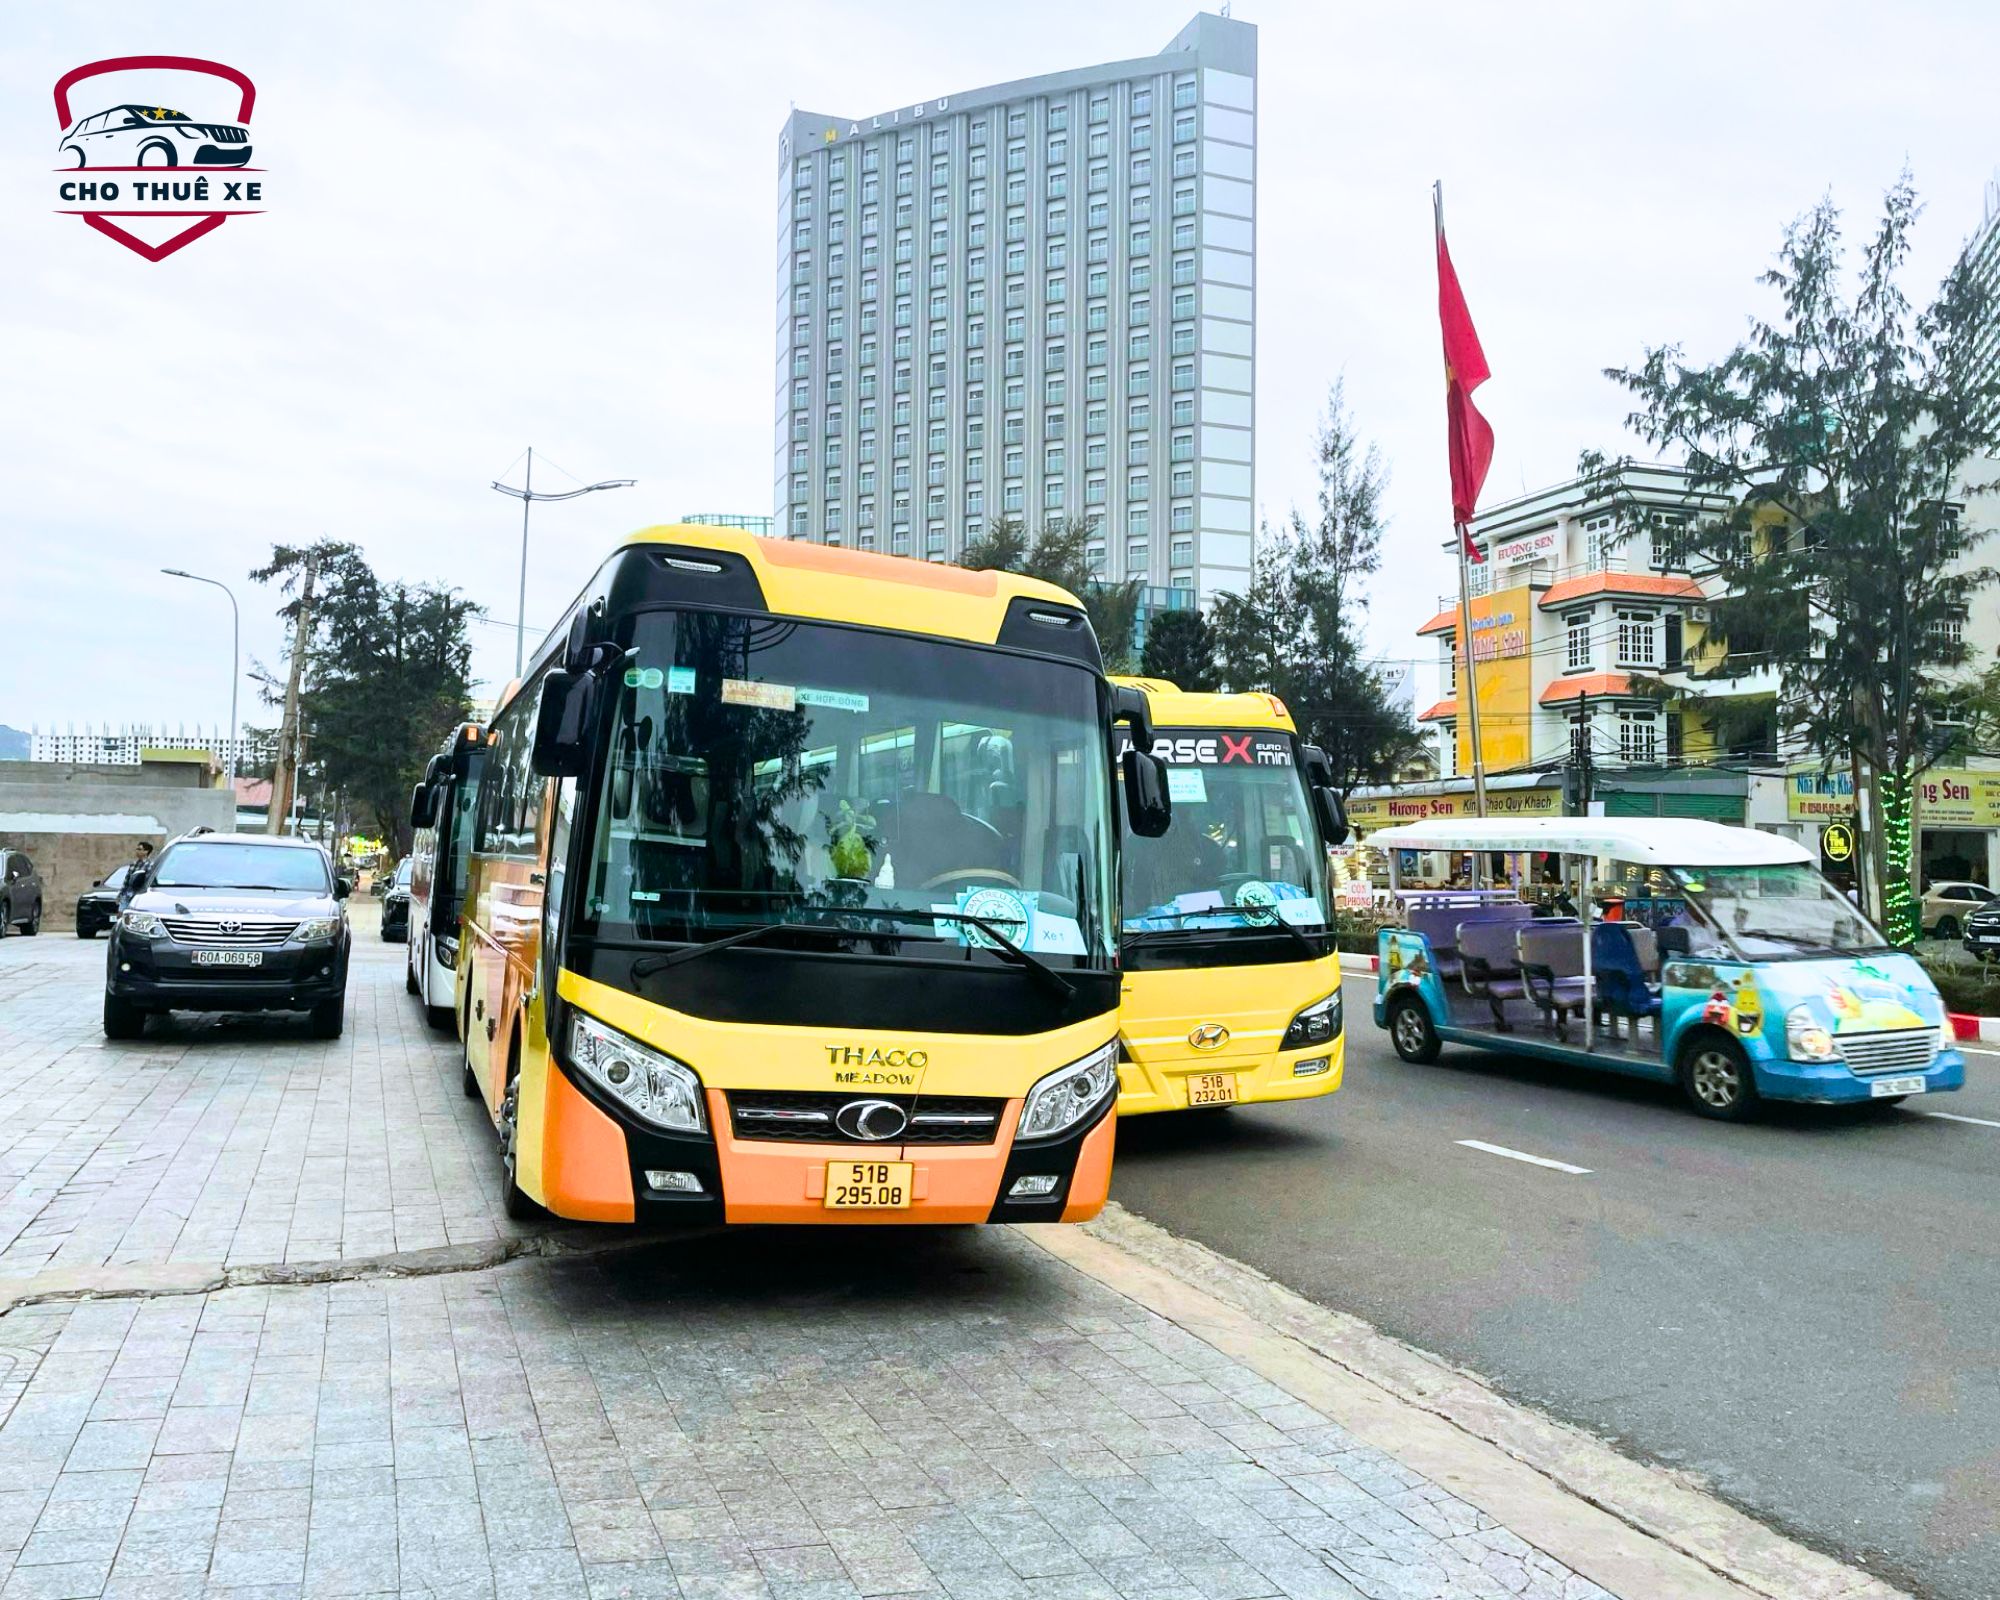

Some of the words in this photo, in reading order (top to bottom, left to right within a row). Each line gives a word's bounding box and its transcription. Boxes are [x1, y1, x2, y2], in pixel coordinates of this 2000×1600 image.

[825, 97, 949, 143] MALIBU
[1534, 534, 1554, 549] SEN
[1512, 551, 1539, 562] HOTEL
[1221, 735, 1254, 764] X
[1255, 743, 1281, 751] EURO
[1942, 778, 1969, 799] Sen
[1389, 801, 1427, 818] Hương
[1430, 799, 1453, 815] Sen
[1463, 799, 1476, 811] Kín
[825, 1044, 928, 1068] THACO
[835, 1071, 915, 1085] MEADOW
[1201, 1075, 1224, 1089] 51B
[1195, 1088, 1232, 1103] 232.01
[852, 1164, 889, 1184] 51B
[835, 1186, 902, 1205] 295.08
